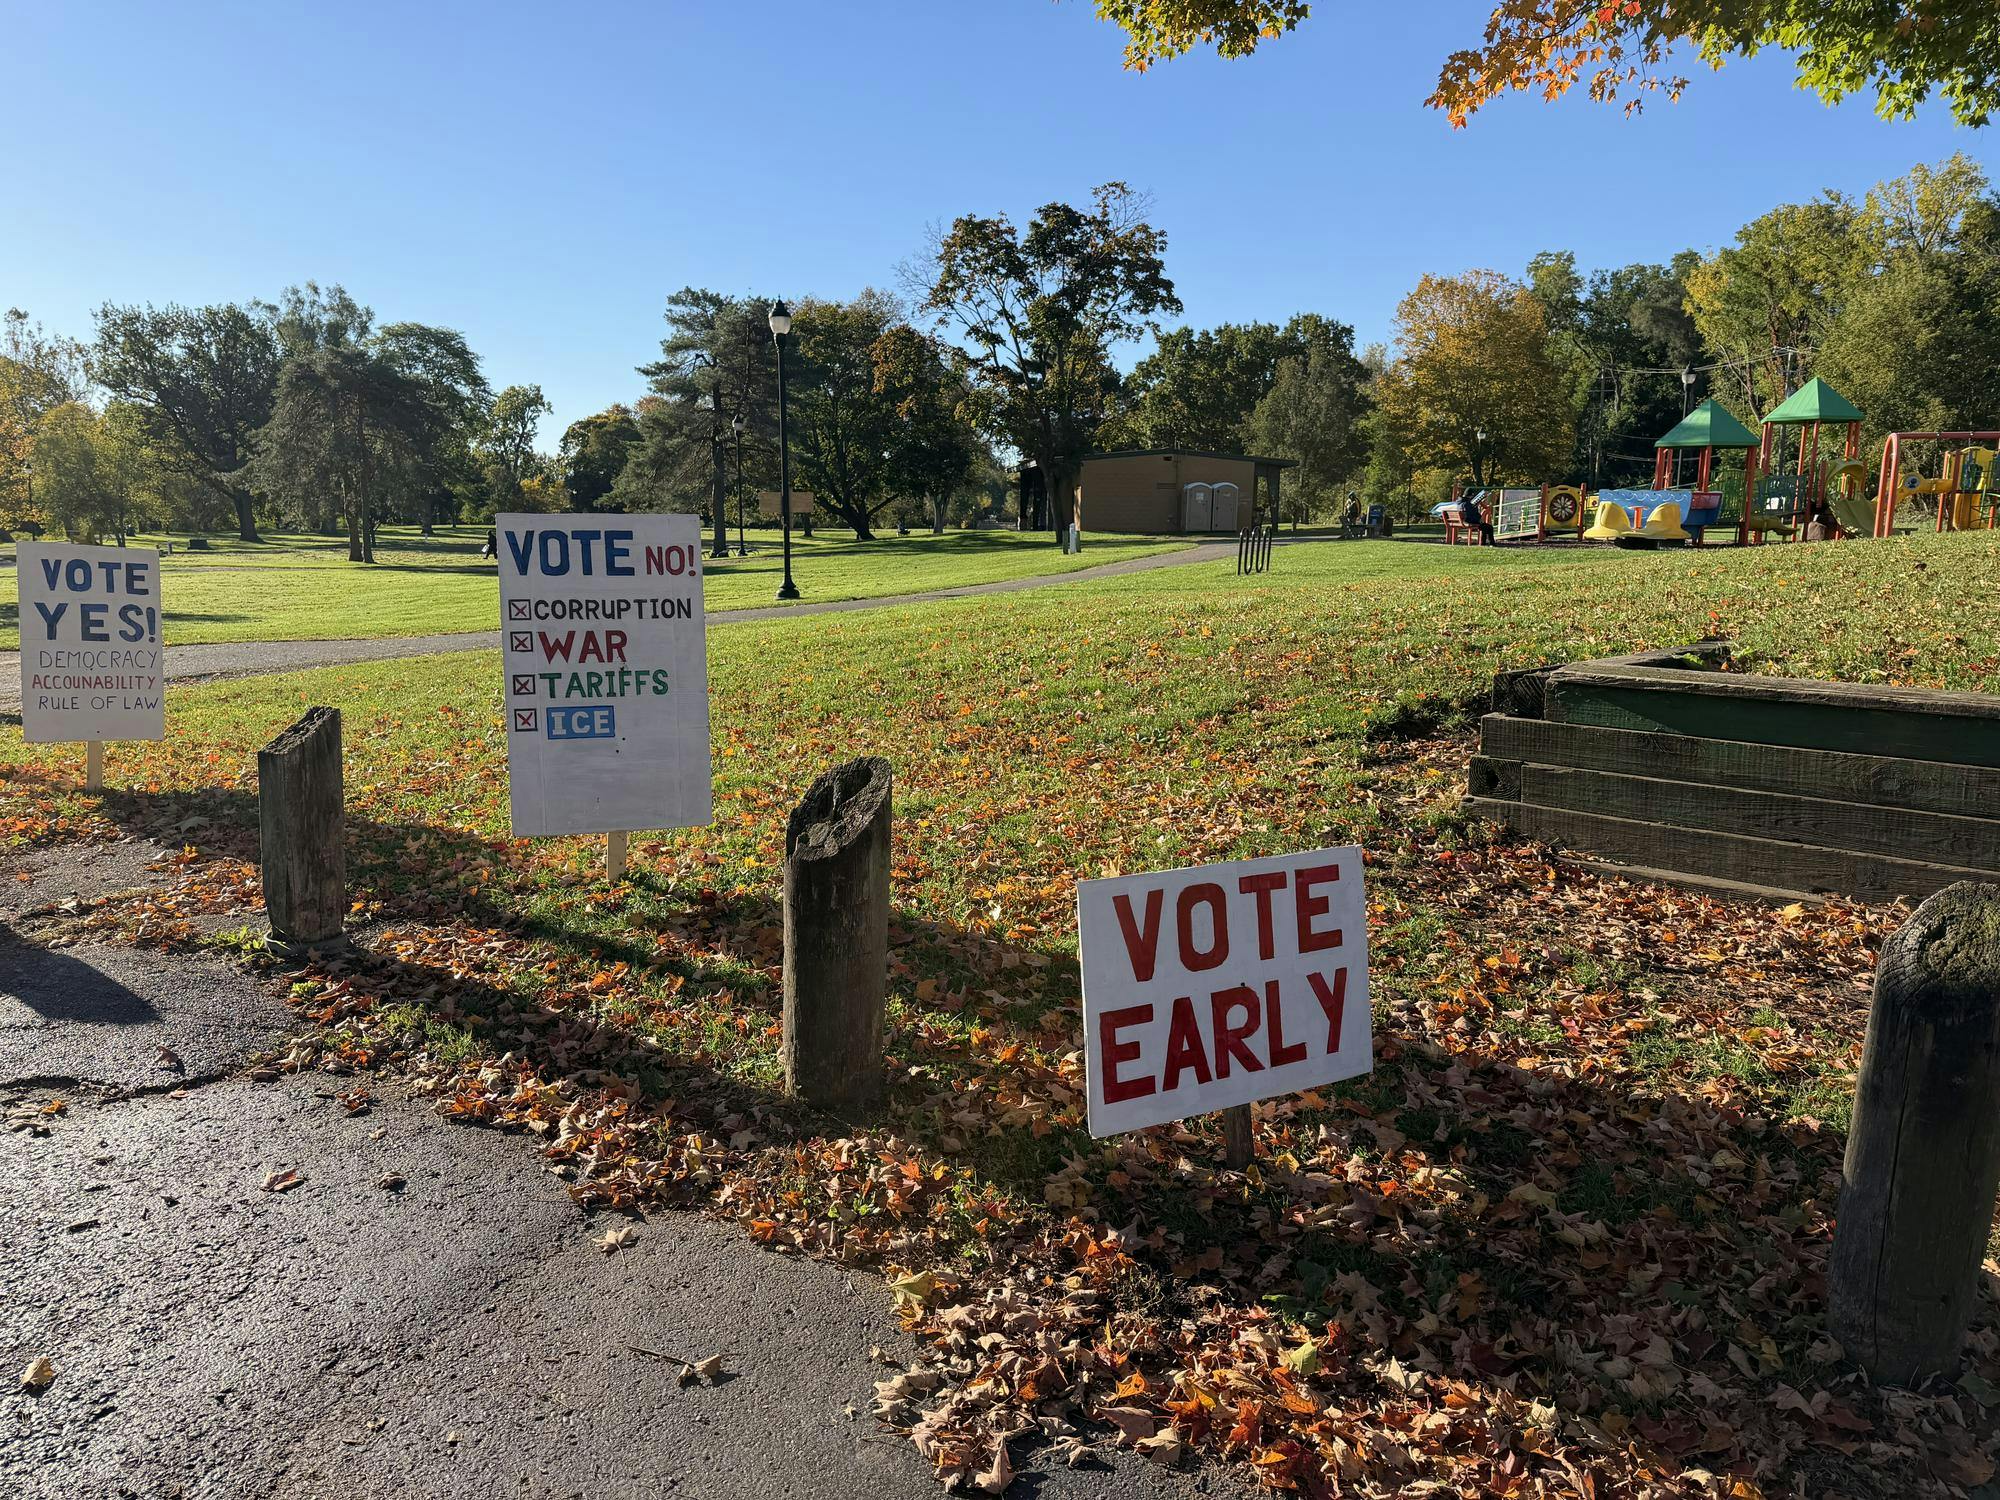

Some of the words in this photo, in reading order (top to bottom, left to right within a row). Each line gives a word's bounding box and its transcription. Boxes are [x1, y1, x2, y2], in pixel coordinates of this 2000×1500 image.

[505, 530, 635, 576] VOTE
[646, 544, 697, 577] NO!
[40, 558, 149, 595] VOTE
[34, 602, 156, 642] YES!
[534, 598, 692, 620] CORRUPTION
[39, 650, 158, 669] DEMOCRACY
[538, 630, 628, 664] WAR
[32, 674, 156, 690] ACCOUNABILITY
[539, 669, 669, 699] TARIFFS
[38, 695, 80, 710] RULE
[90, 695, 117, 710] OF
[123, 697, 159, 710] LAW
[551, 709, 610, 736] ICE
[1112, 864, 1343, 982] VOTE
[1099, 967, 1348, 1104] EARLY
